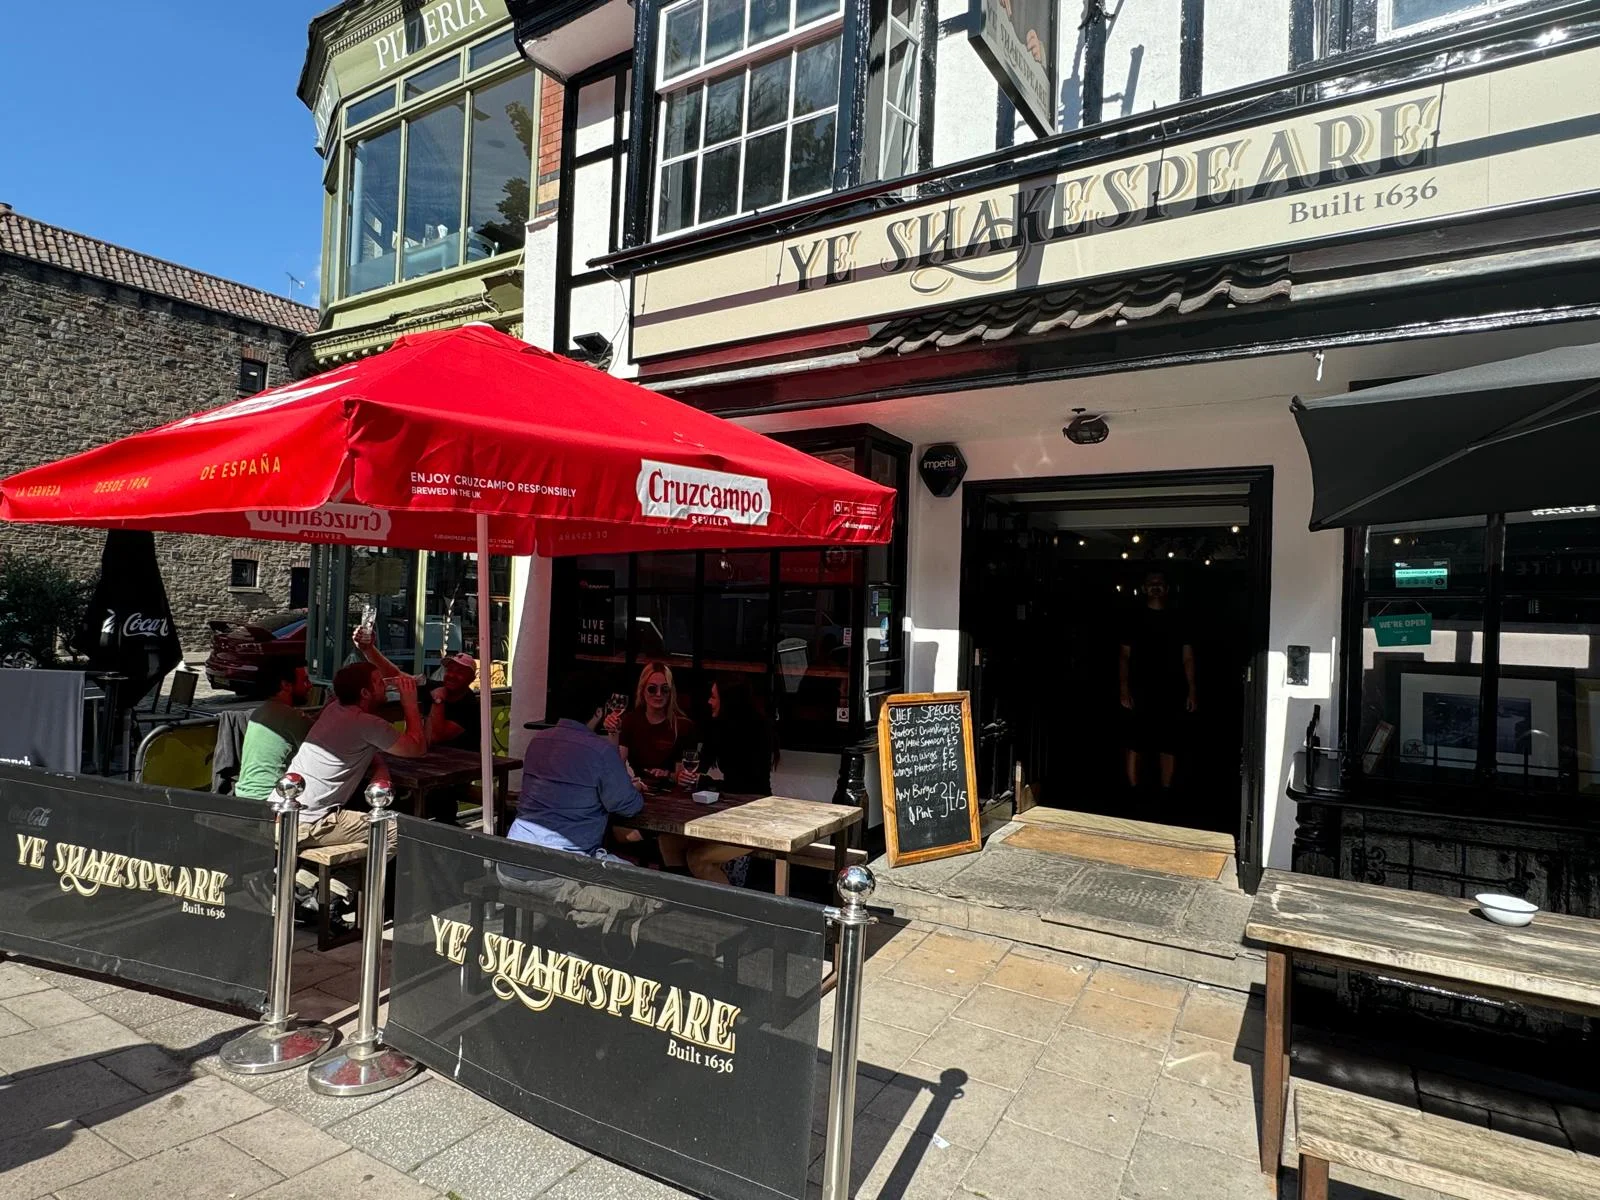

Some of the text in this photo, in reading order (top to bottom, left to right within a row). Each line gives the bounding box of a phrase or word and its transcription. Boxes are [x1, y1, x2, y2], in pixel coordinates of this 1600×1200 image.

[373, 0, 489, 71] PIZZERIA
[787, 95, 1442, 294] YE SHAKESPEARE
[1289, 178, 1439, 226] Built 1636
[200, 453, 282, 481] DE ESPAÑA
[923, 457, 957, 471] imperial
[15, 485, 62, 498] LA CERVEZA
[93, 477, 152, 495] DESDE 1904
[410, 471, 577, 498] ENJOY CRUZCAMPO RESPONSIBLY
[411, 486, 482, 499] BREWED IN THE UK
[648, 468, 764, 517] Cruzcampo
[691, 515, 729, 527] SEVILLA
[582, 618, 605, 630] LIVE
[1379, 619, 1426, 630] WE'RE OPEN
[580, 633, 606, 646] HERE
[888, 704, 962, 723] CHEF SPECIALS
[950, 721, 961, 735] £5
[946, 734, 959, 747] £5
[942, 746, 955, 761] £5
[942, 759, 958, 772] £15
[912, 782, 939, 801] Burger
[16, 833, 229, 906] YE SHAKESPEARE
[181, 901, 226, 920] Built 1636
[430, 914, 742, 1054] YE SHAKESPEARE
[666, 1038, 734, 1075] Built 1636
